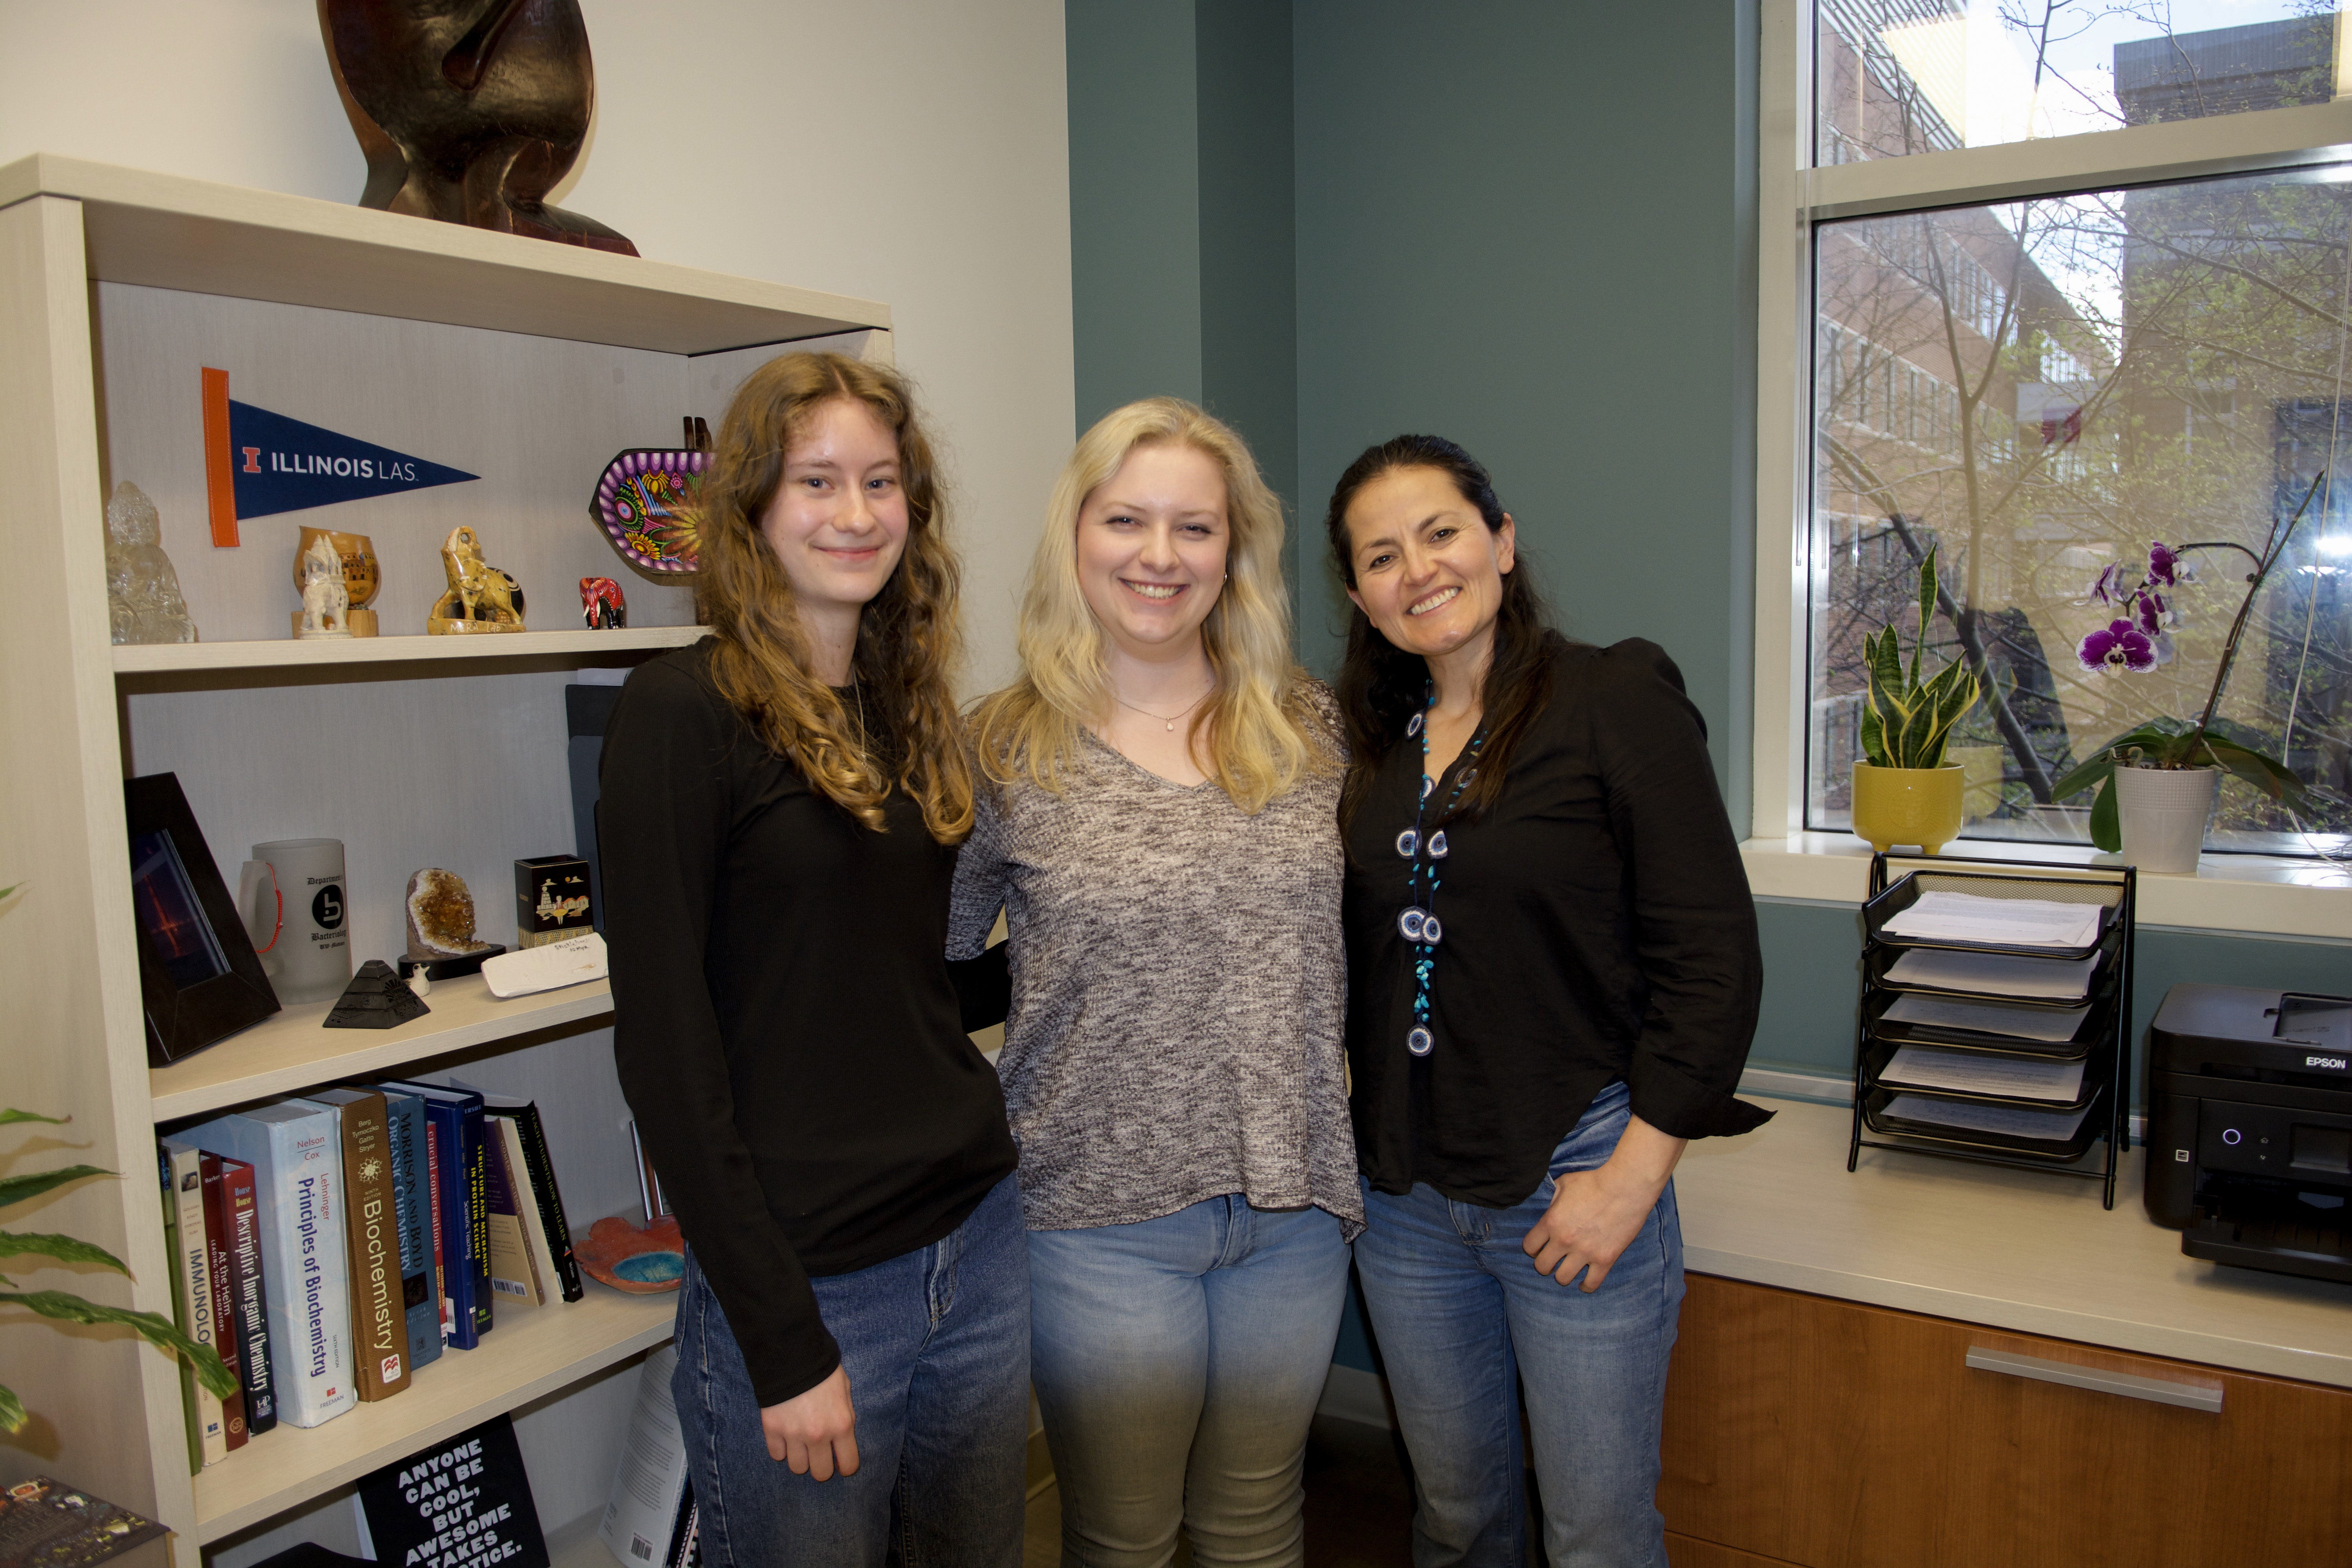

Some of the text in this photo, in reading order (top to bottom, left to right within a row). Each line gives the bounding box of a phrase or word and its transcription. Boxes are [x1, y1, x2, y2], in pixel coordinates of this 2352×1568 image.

[272, 452, 373, 478] ILLINOIS
[379, 461, 415, 481] LAS
[2306, 1056, 2347, 1069] EPSON
[465, 1104, 481, 1114] ERSHT
[297, 1137, 325, 1149] Nelson
[352, 1125, 379, 1138] Tymoczko
[359, 1143, 375, 1152] Stryer
[304, 1151, 319, 1160] Cox
[471, 1167, 476, 1177] IN
[205, 1174, 220, 1183] Barker
[235, 1186, 250, 1196] House
[388, 1116, 411, 1271] ORGANIC CHEMISTRY
[401, 1112, 423, 1268] MORRISON AND BOYD
[428, 1131, 441, 1252] crucial conversations
[501, 1139, 511, 1171] WOMEN
[510, 1181, 522, 1215] SCIENCE
[531, 1110, 566, 1241] TEACH STUDENTS HOW TO LEARN
[236, 1197, 252, 1207] House
[321, 1173, 330, 1220] Lehninger
[364, 1192, 381, 1201] EDITION
[235, 1209, 259, 1275] Descriptive
[218, 1252, 232, 1316] At the Helm
[298, 1177, 327, 1377] Principles of Biochemistry
[364, 1200, 393, 1348] Biochemistry
[190, 1248, 211, 1344] IMMUNOLO
[216, 1291, 225, 1332] LABORATORY
[241, 1275, 265, 1333] Inorganic
[223, 1353, 236, 1363] Second
[249, 1333, 270, 1391] Chemistry
[320, 1394, 344, 1409] FREEMAN
[398, 1438, 483, 1489] ANYONE
[405, 1457, 484, 1504] CAN BE
[419, 1483, 480, 1517] COOL,
[432, 1500, 475, 1532] BUT
[406, 1503, 512, 1567] AWESOME
[426, 1530, 498, 1568] TAKES
[458, 1539, 523, 1568] TICE.
